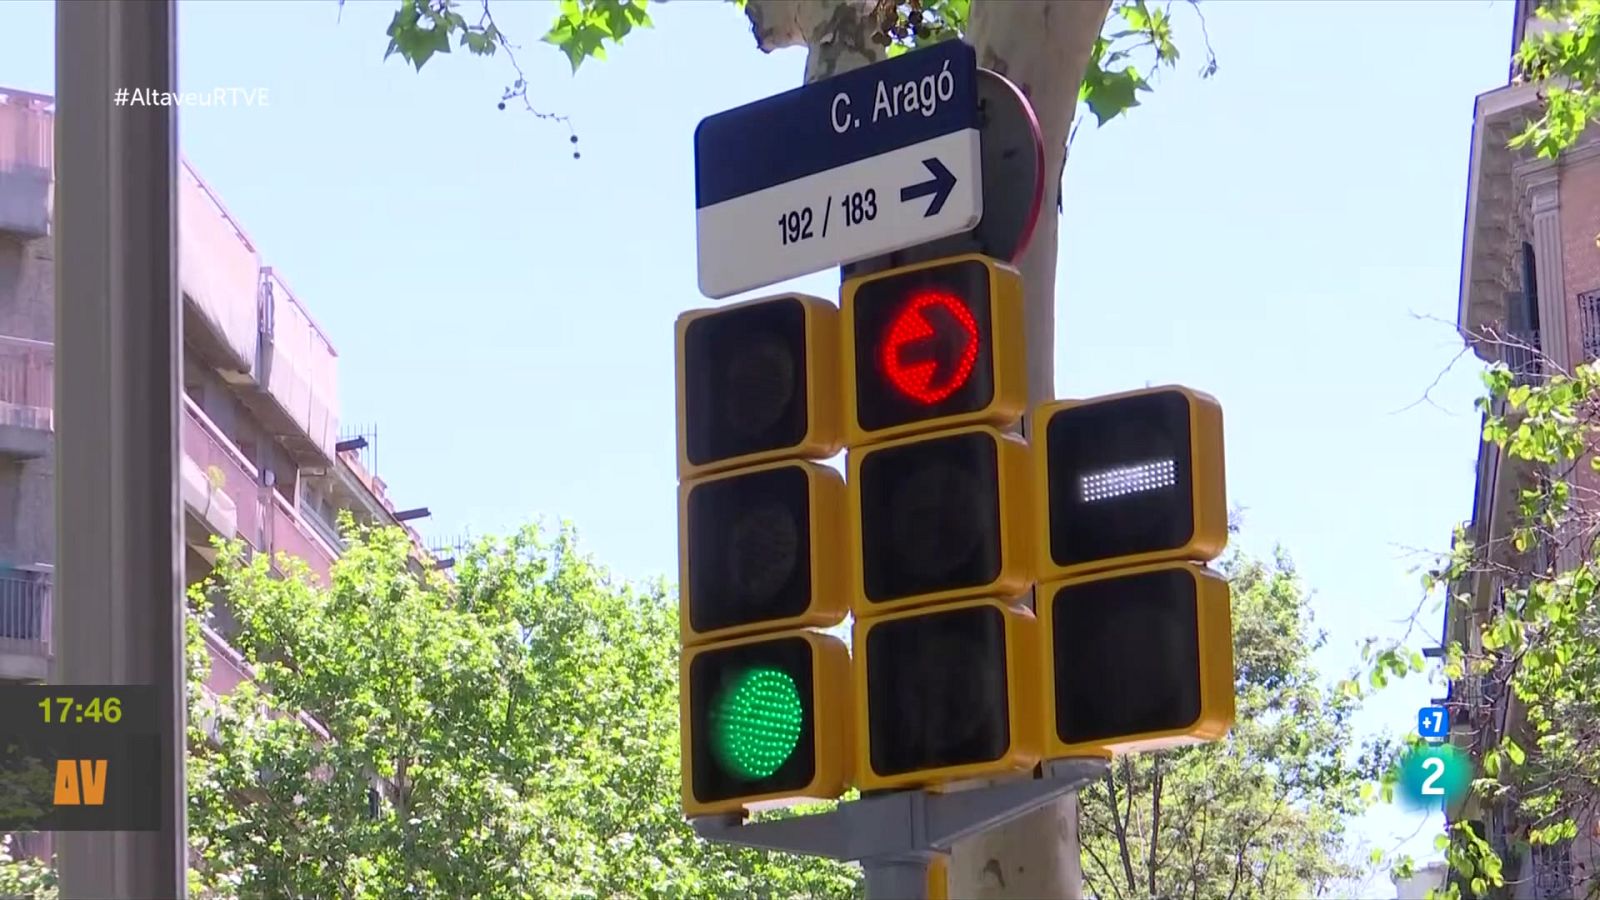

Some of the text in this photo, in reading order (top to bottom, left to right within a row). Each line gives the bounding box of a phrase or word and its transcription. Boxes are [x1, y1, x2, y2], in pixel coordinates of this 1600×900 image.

[831, 60, 954, 133] C. Aragó
[778, 188, 878, 245] 192 / 183
